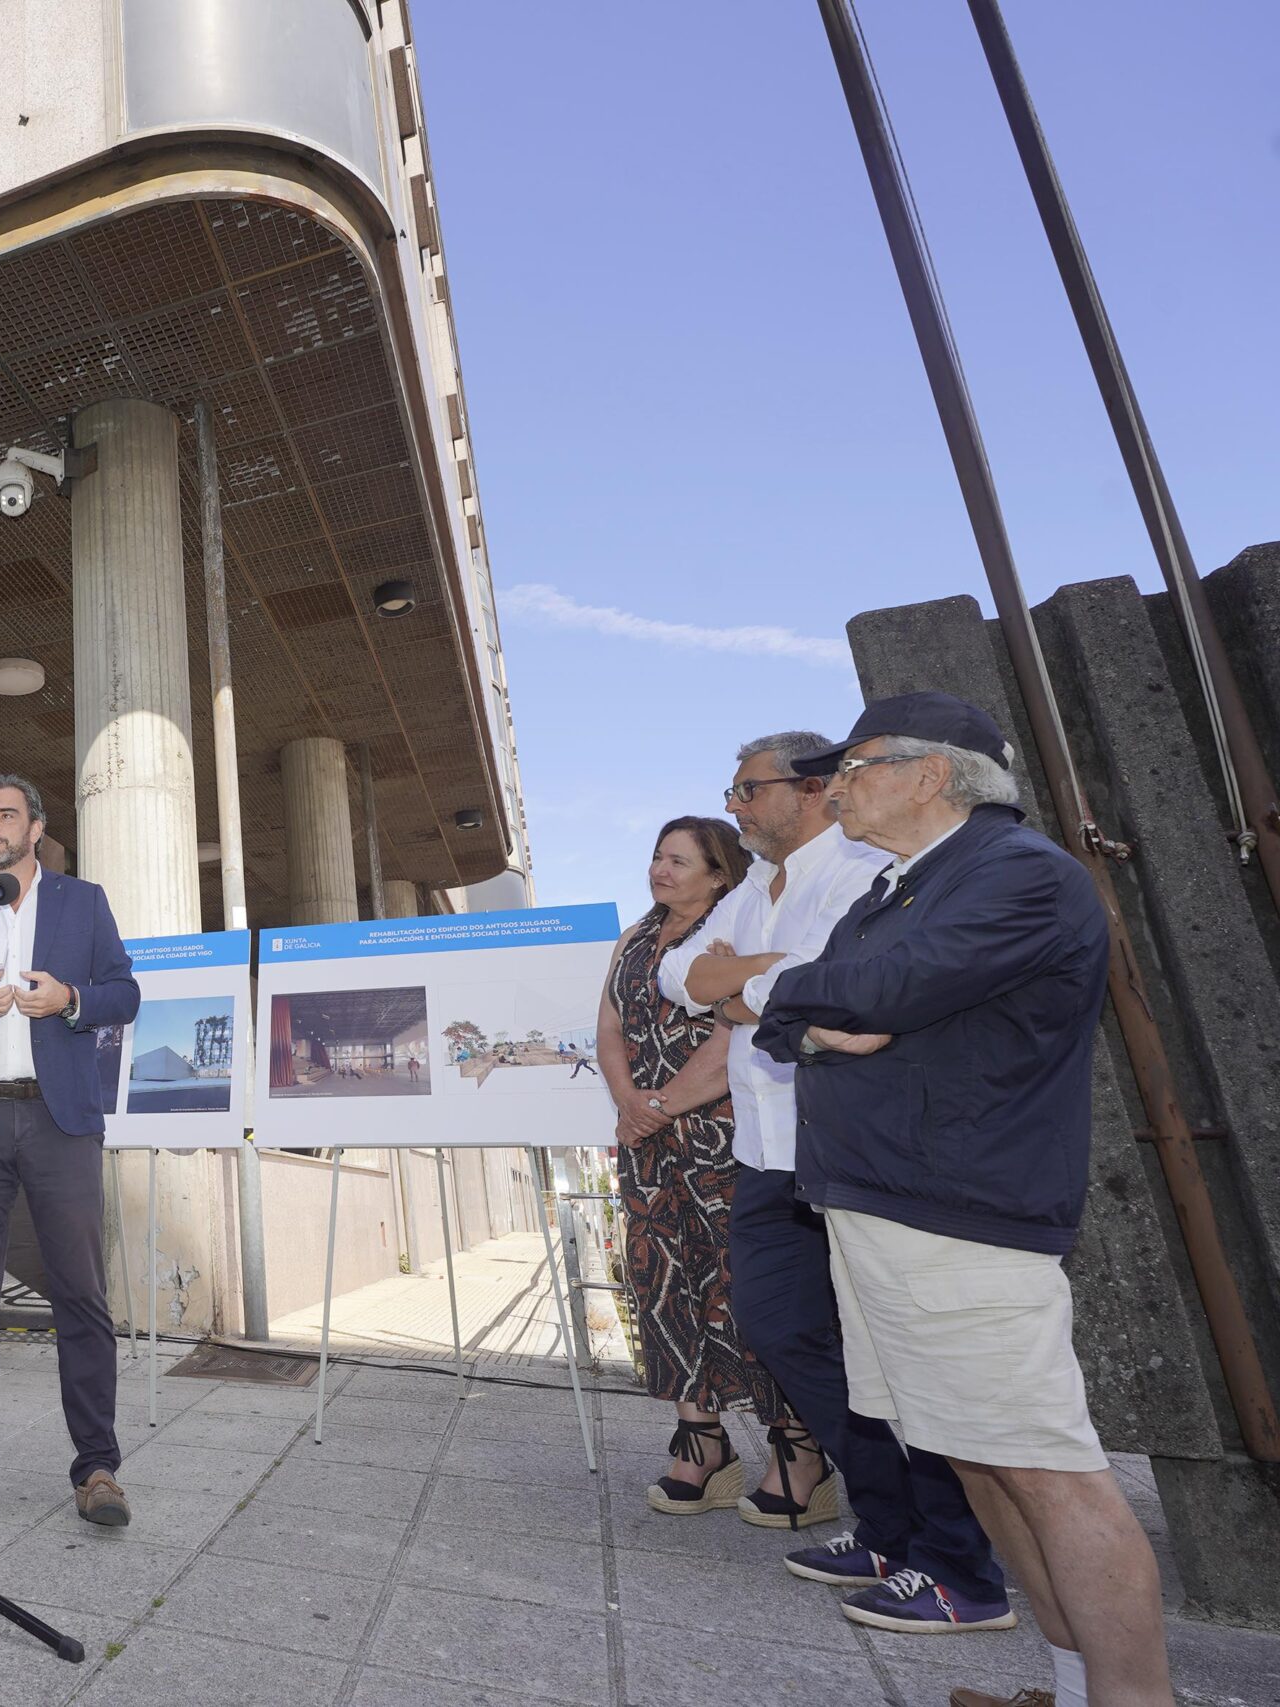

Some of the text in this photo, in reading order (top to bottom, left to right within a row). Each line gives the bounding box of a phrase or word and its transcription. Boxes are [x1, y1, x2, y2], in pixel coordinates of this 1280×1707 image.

[369, 927, 425, 937] REHABILITACIÓN
[519, 919, 560, 927] XULGADOS
[379, 935, 424, 943] ASOCIACIÓNS
[431, 932, 470, 940] ENTIDADES
